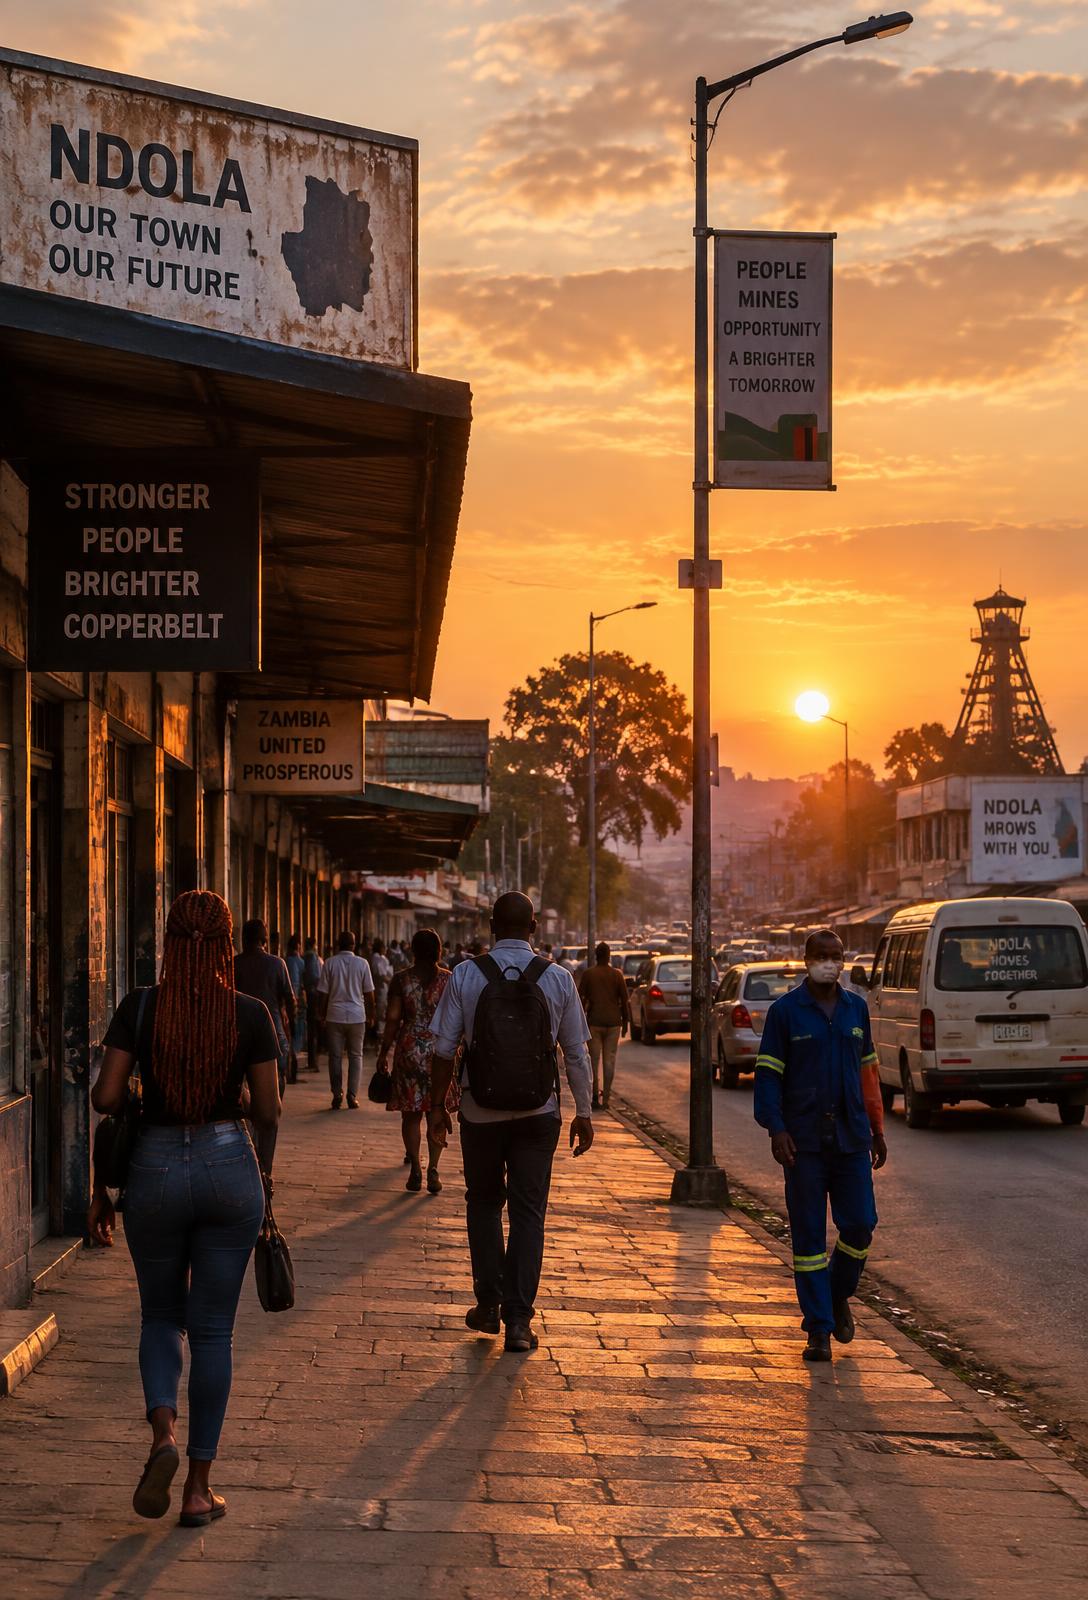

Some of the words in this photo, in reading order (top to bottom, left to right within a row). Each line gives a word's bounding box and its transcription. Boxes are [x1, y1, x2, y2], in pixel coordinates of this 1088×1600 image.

[50, 123, 252, 213] NDOLA
[49, 199, 118, 238] OUR
[130, 212, 221, 256] TOWN
[49, 243, 115, 282] OUR
[128, 256, 241, 301] FUTURE
[737, 260, 807, 280] PEOPLE
[738, 290, 799, 309] MINES
[723, 321, 821, 337] OPPORTUNITY
[728, 351, 739, 366] A
[743, 351, 815, 367] BRIGHTER
[728, 378, 815, 393] TOMORROW
[64, 482, 210, 510] STRONGER
[82, 526, 183, 553] PEOPLE
[65, 570, 200, 597] BRIGHTER
[63, 612, 224, 640] COPPERBELT
[258, 710, 331, 729] ZAMBIA
[259, 737, 326, 755] UNITED
[242, 763, 354, 781] PROSPEROUS
[984, 798, 1042, 815] NDOLA
[984, 821, 1037, 836] MROWS
[983, 841, 1017, 855] WITH
[1023, 841, 1050, 855] YOU
[989, 937, 1032, 951] NDOLA
